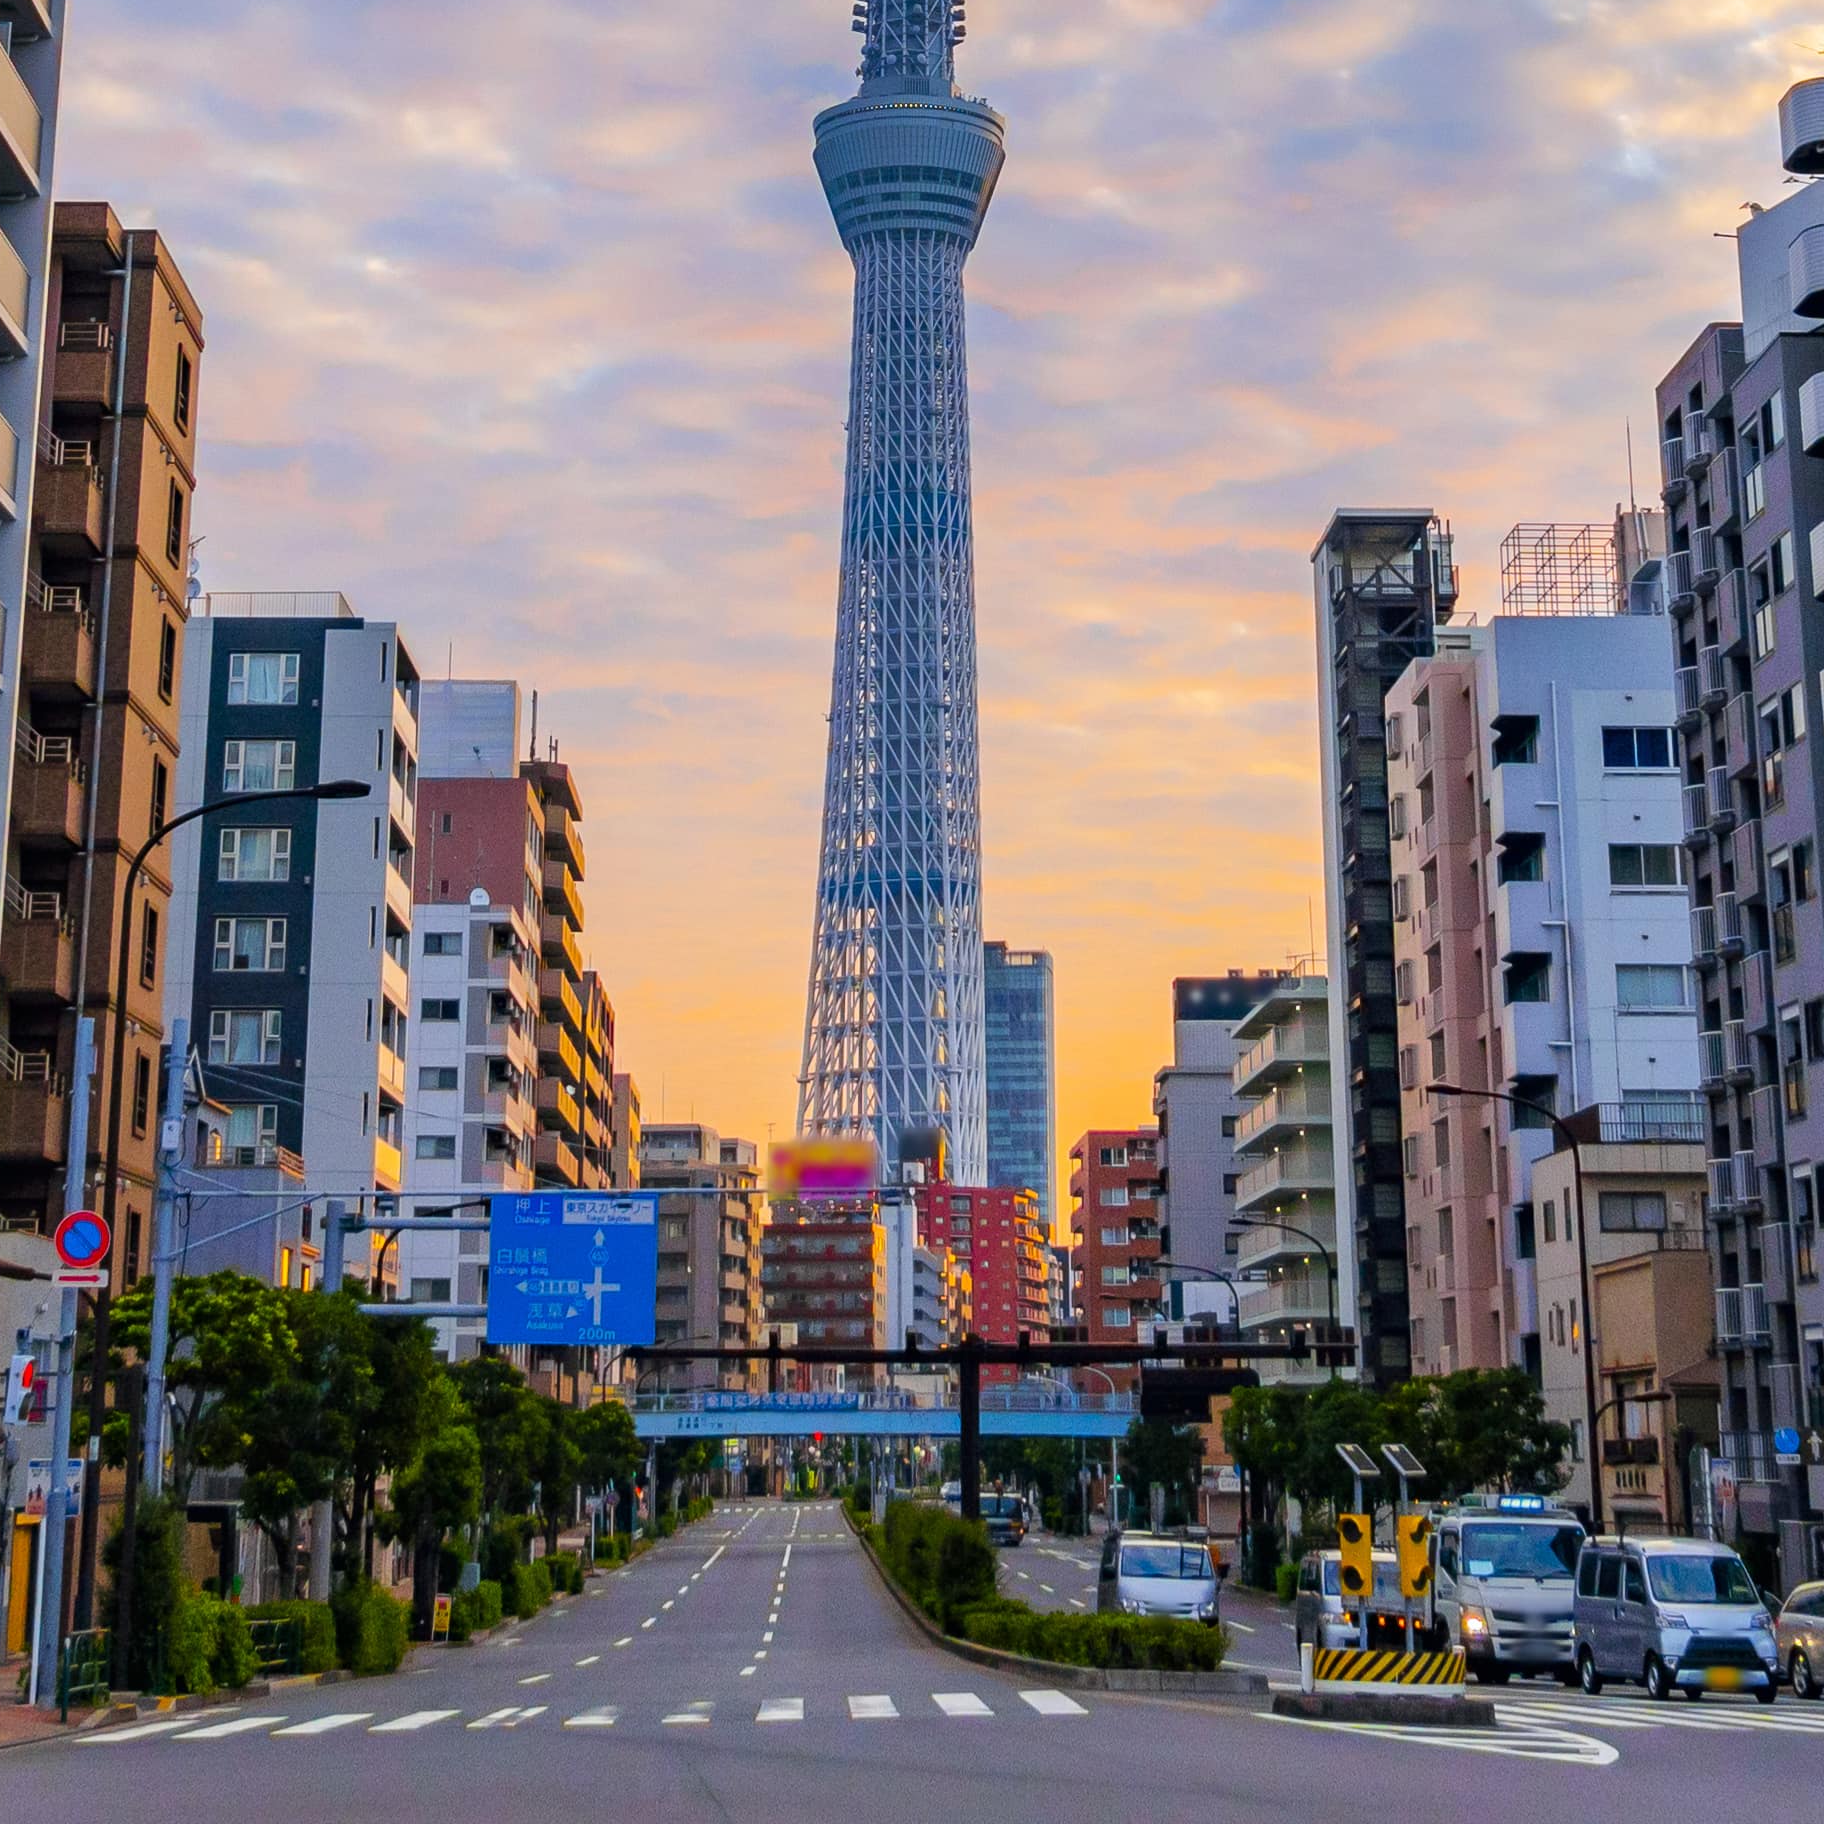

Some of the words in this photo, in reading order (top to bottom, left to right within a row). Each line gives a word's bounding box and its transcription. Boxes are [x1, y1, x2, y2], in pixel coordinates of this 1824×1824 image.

[515, 1198, 551, 1215] 押上
[515, 1215, 551, 1225] Oshiage
[528, 1303, 563, 1318] 浅草
[526, 1320, 564, 1329] Asakusa
[578, 1328, 616, 1340] 200m
